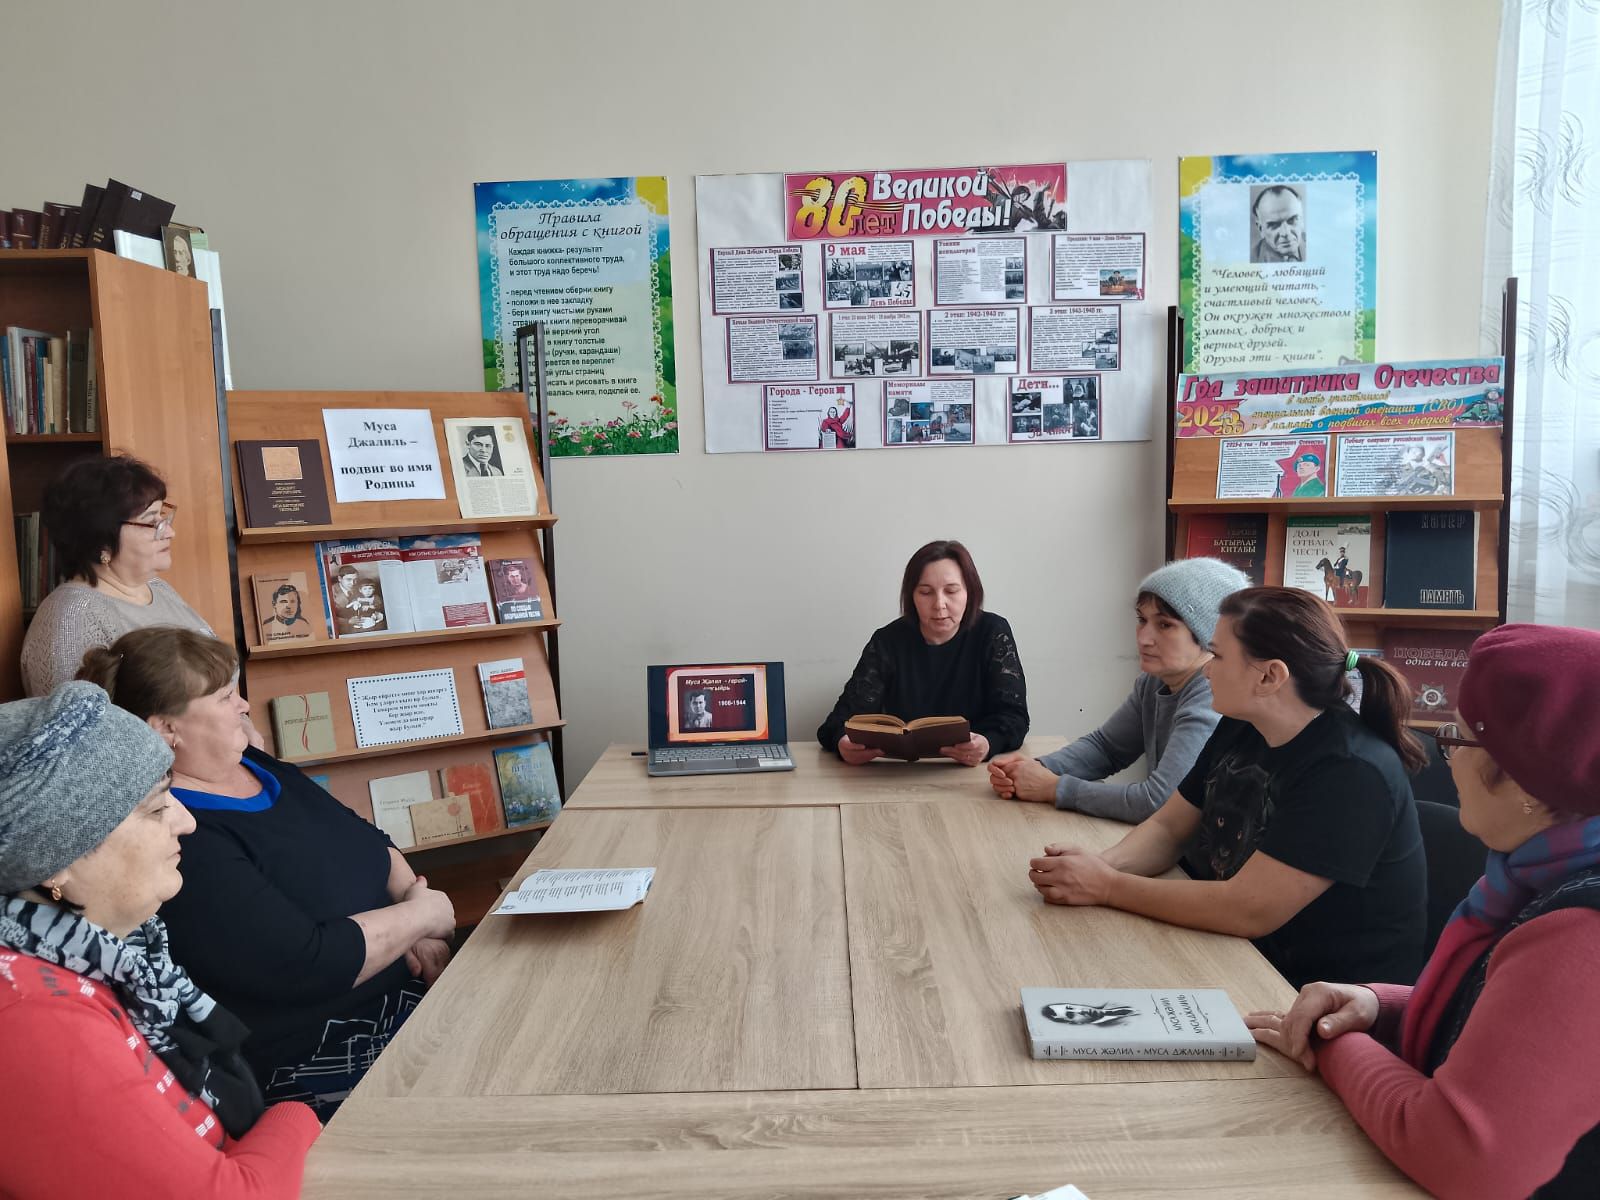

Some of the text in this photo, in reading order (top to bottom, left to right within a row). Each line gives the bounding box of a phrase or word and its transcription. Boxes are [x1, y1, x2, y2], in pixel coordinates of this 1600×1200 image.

[872, 170, 989, 202] Великой
[793, 176, 898, 238] 80 лет
[539, 212, 601, 228] Правила
[902, 199, 1012, 234] Победы!
[500, 224, 643, 243] обращения с книгой
[827, 244, 836, 256] 9
[840, 245, 867, 257] мая
[1272, 266, 1326, 281] любящий
[1204, 286, 1211, 294] и
[1212, 282, 1269, 296] умеющий
[1203, 296, 1273, 308] счастливый
[1203, 309, 1351, 325] Он окружен множеством
[1251, 322, 1294, 338] добрых
[1202, 340, 1244, 353] верных
[1202, 353, 1246, 369] Друзья
[1183, 375, 1224, 401] Год
[1374, 364, 1500, 390] Отечества
[769, 387, 801, 398] Города
[808, 386, 835, 397] Герои
[1421, 398, 1464, 414] (СВО)
[1178, 402, 1242, 427] 2025
[1380, 415, 1402, 426] всех
[1407, 413, 1452, 428] предков
[362, 420, 397, 433] Муса
[348, 436, 408, 449] Джалиль
[340, 462, 433, 476] подвиг во имя
[365, 477, 416, 491] Родины
[1292, 539, 1334, 547] ОТВАГА
[1292, 548, 1328, 556] ЧЕСТЬ
[1420, 588, 1465, 605] ПАМЯТЬ
[1393, 646, 1469, 660] ПОБЕДА
[1405, 657, 1470, 668] одна на все
[1072, 1046, 1098, 1056] МУСА
[1143, 1046, 1169, 1057] МУСА
[1171, 1046, 1215, 1057] ДЖАЛИЛЬ
